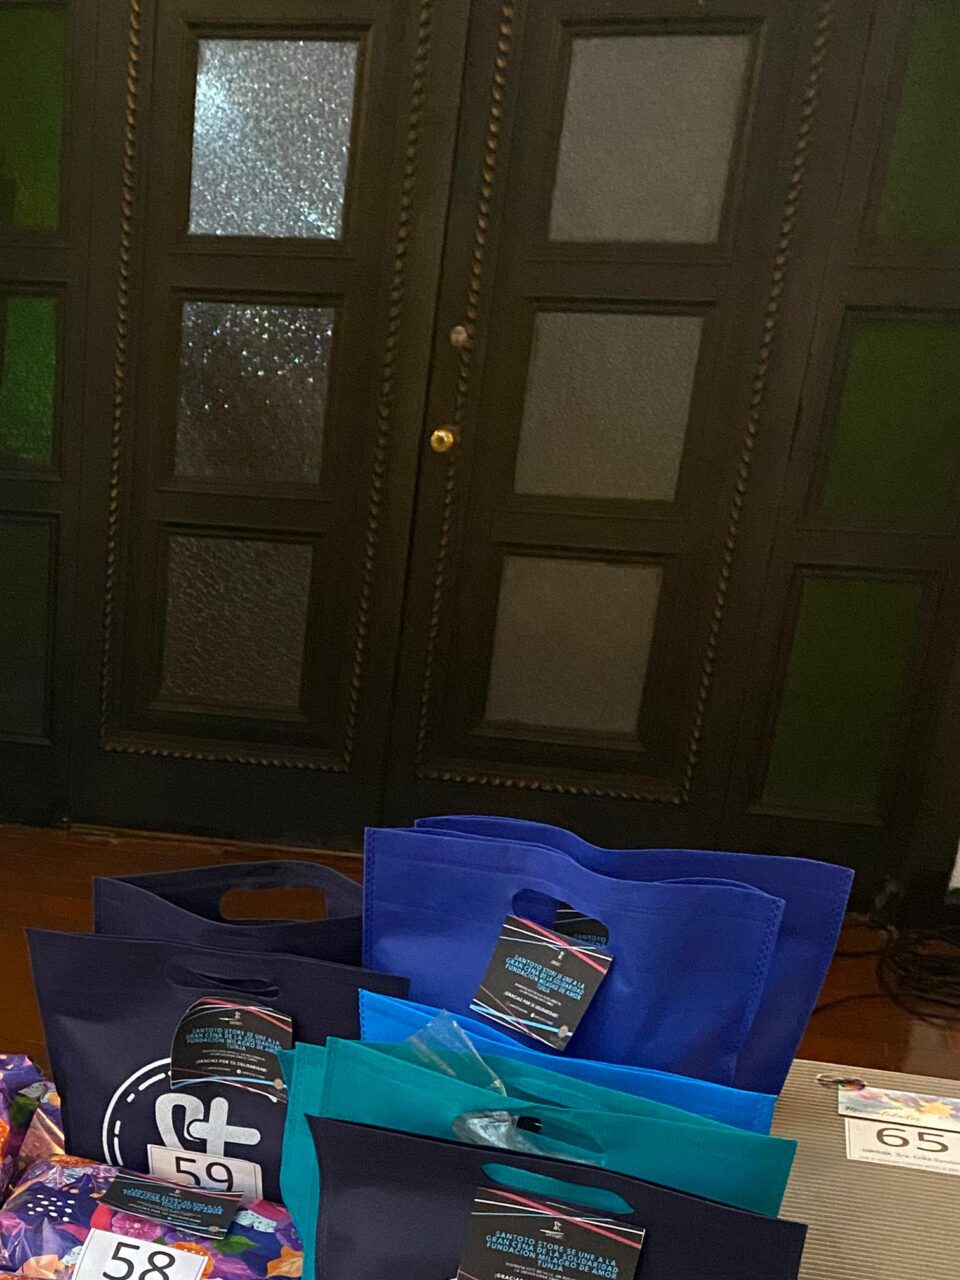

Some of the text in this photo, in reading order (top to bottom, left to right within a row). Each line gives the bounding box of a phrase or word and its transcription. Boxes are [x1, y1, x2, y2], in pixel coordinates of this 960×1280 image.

[876, 1127, 949, 1153] 65
[175, 1156, 234, 1192] 59
[486, 1235, 509, 1245] GRAN
[512, 1241, 534, 1251] CENA
[496, 1231, 535, 1245] SANTOTO
[537, 1241, 564, 1252] STORE
[537, 1260, 563, 1272] TUNJA
[591, 1267, 617, 1280] AMOR
